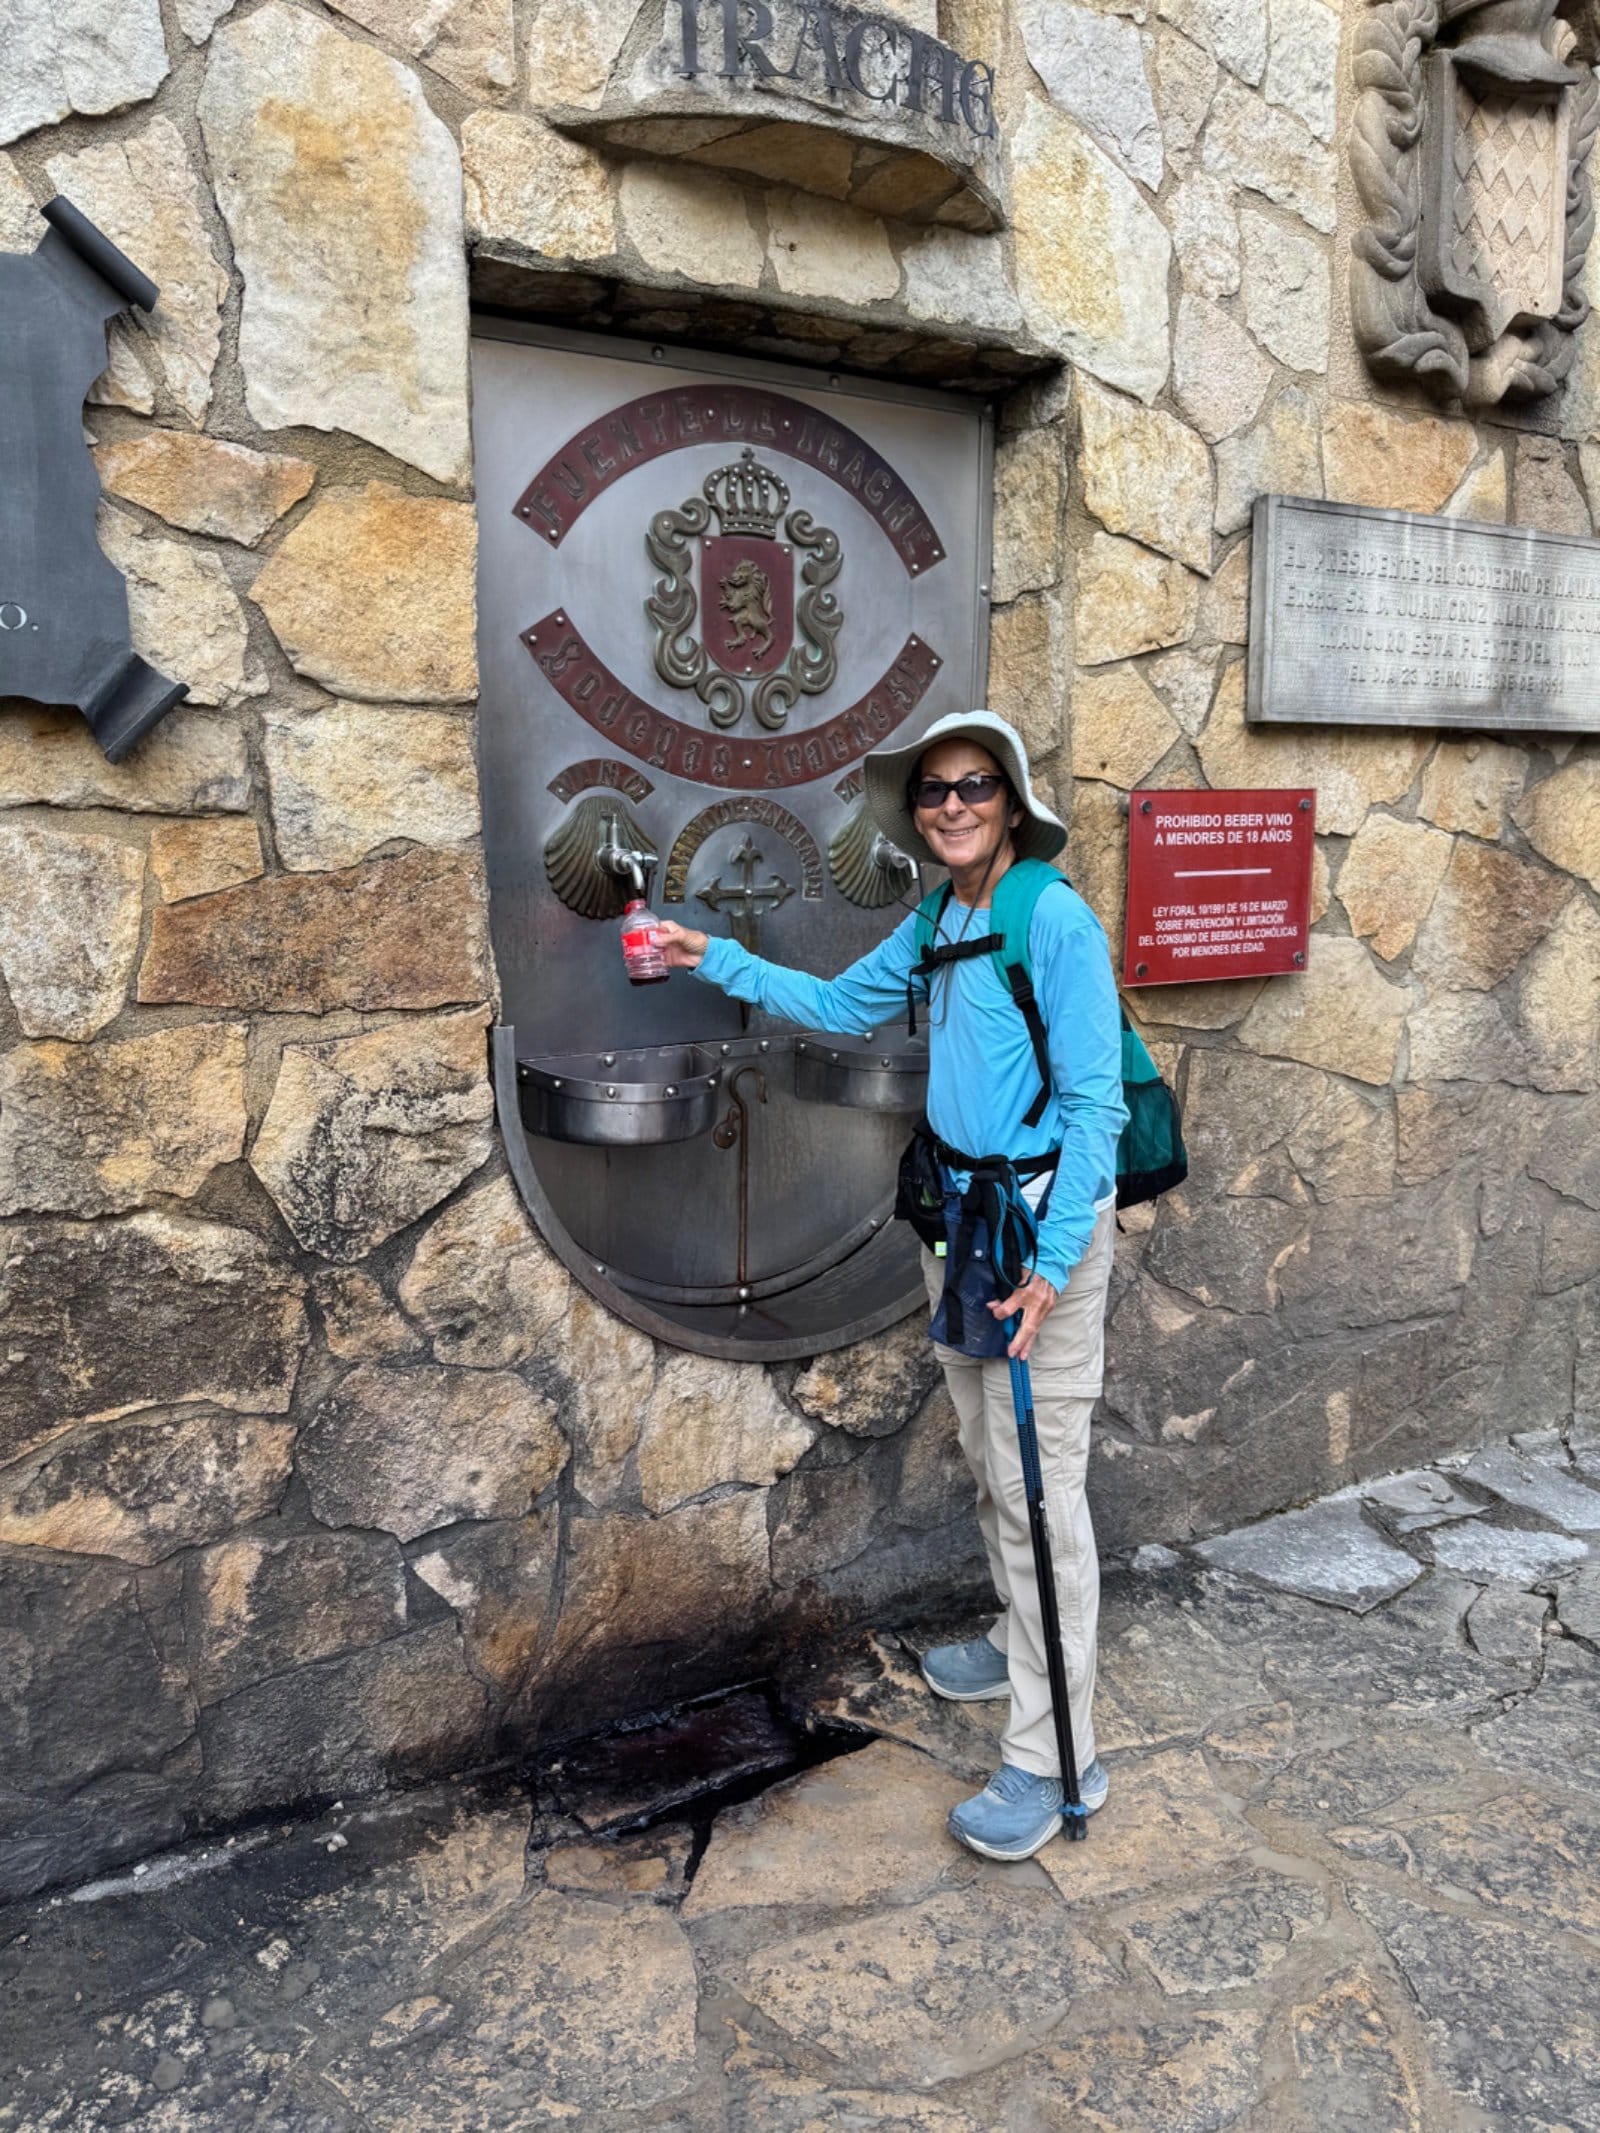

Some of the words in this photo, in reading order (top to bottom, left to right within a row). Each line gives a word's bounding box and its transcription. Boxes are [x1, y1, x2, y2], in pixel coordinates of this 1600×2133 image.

[673, 0, 997, 141] IRACHE
[530, 397, 703, 527] FUENTE
[797, 416, 932, 556] IRACHE
[1155, 814, 1222, 829] PROHIBIDO
[1224, 813, 1264, 828] BEBER
[1266, 812, 1294, 826] VINO
[1154, 833, 1164, 846] A
[1166, 831, 1225, 846] MENORES
[1227, 831, 1243, 844] DE
[1246, 830, 1259, 843] 18
[1260, 827, 1293, 843] AÑOS
[1152, 906, 1169, 918] LEY
[1170, 904, 1197, 917] FORAL
[1226, 902, 1238, 914] DE
[1249, 901, 1260, 913] DE
[1261, 900, 1289, 912] MARZO
[1155, 919, 1183, 932] SOBRE
[1184, 915, 1235, 930] PREVENCIÓN
[1236, 915, 1242, 926] Y
[1138, 935, 1155, 947] DEL
[1156, 932, 1197, 946] CONSUMO
[1198, 931, 1209, 943] DE
[1210, 929, 1245, 942] BEBIDAS
[1172, 946, 1190, 958] POR
[1191, 943, 1230, 957] MENORES
[1230, 943, 1242, 954] DE
